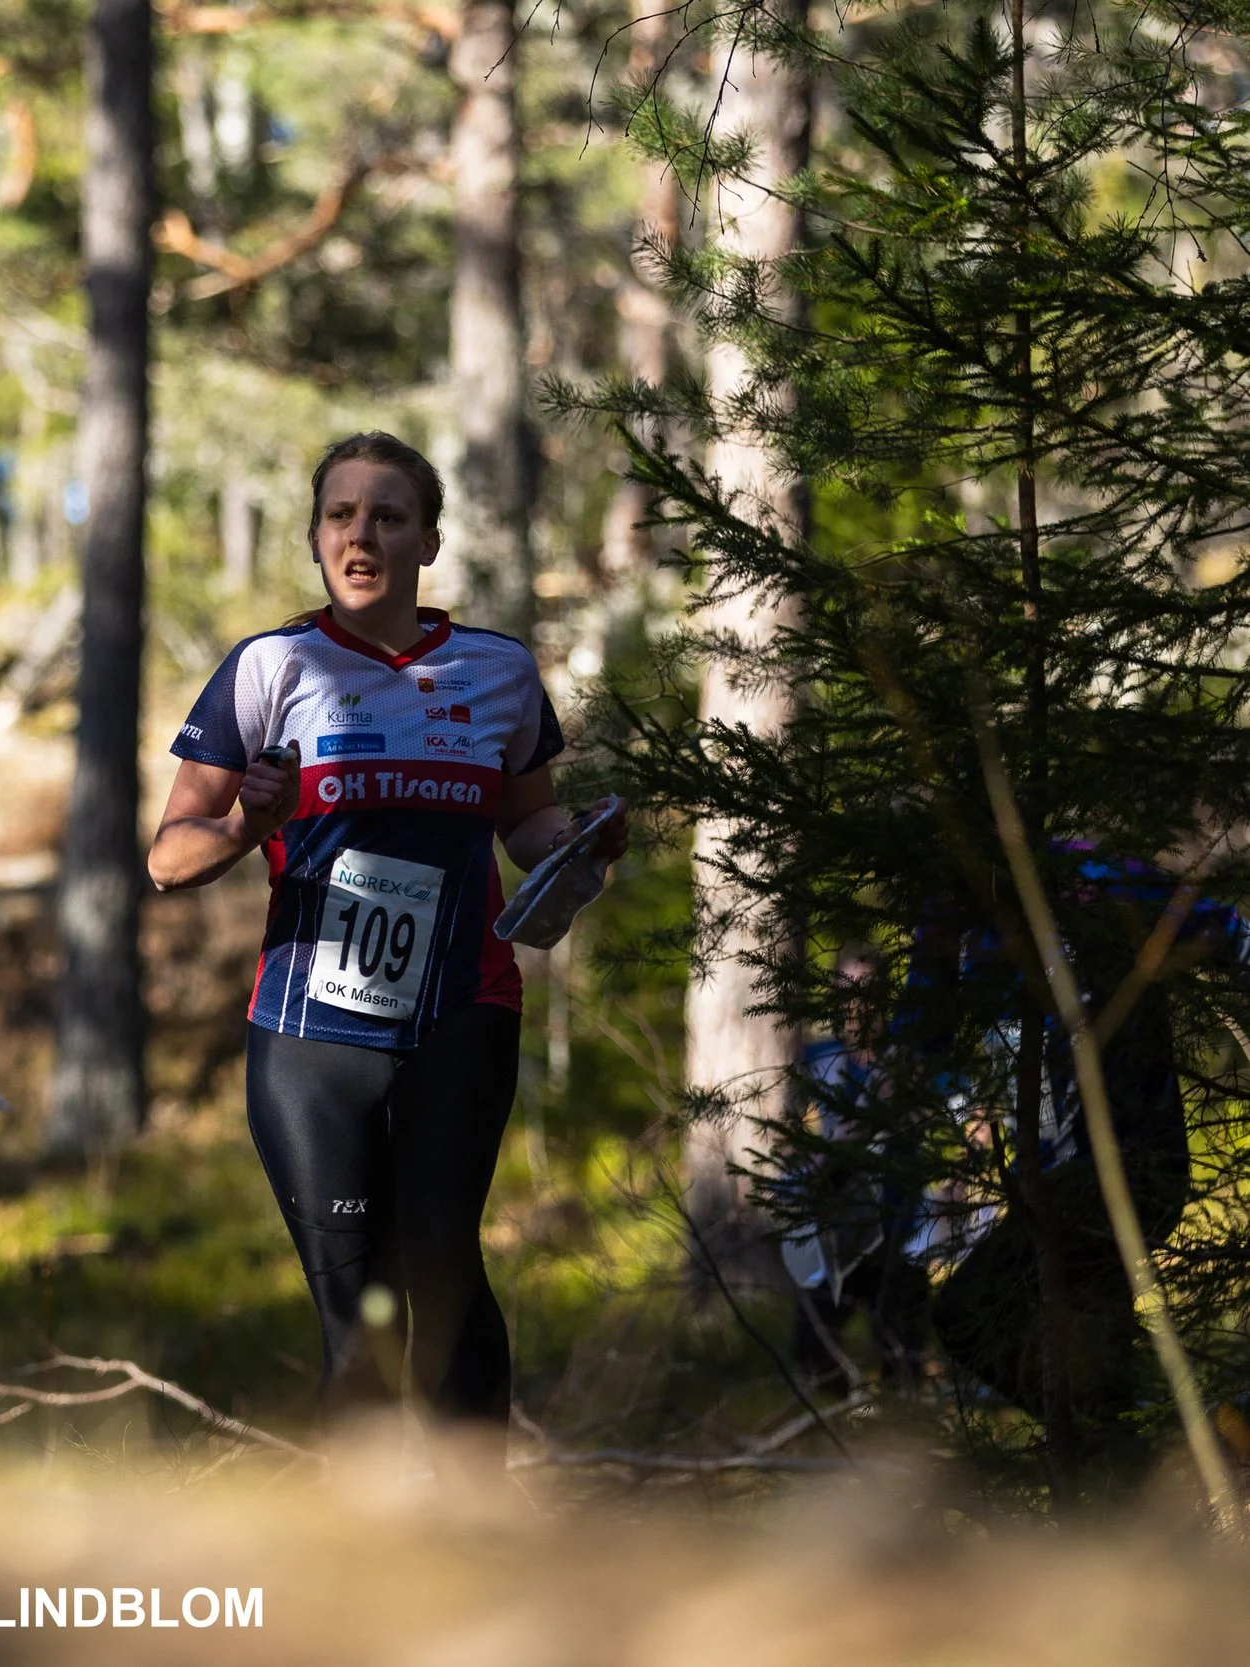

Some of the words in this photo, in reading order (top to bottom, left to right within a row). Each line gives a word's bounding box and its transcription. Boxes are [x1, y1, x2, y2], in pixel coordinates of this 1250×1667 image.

[327, 710, 372, 724] Kumla
[426, 736, 447, 747] ICA
[318, 772, 365, 803] OK
[375, 772, 482, 804] Tisaren
[339, 870, 402, 896] NOREX
[338, 900, 416, 983] 109
[325, 981, 347, 998] OK
[350, 987, 399, 1009] Måsen
